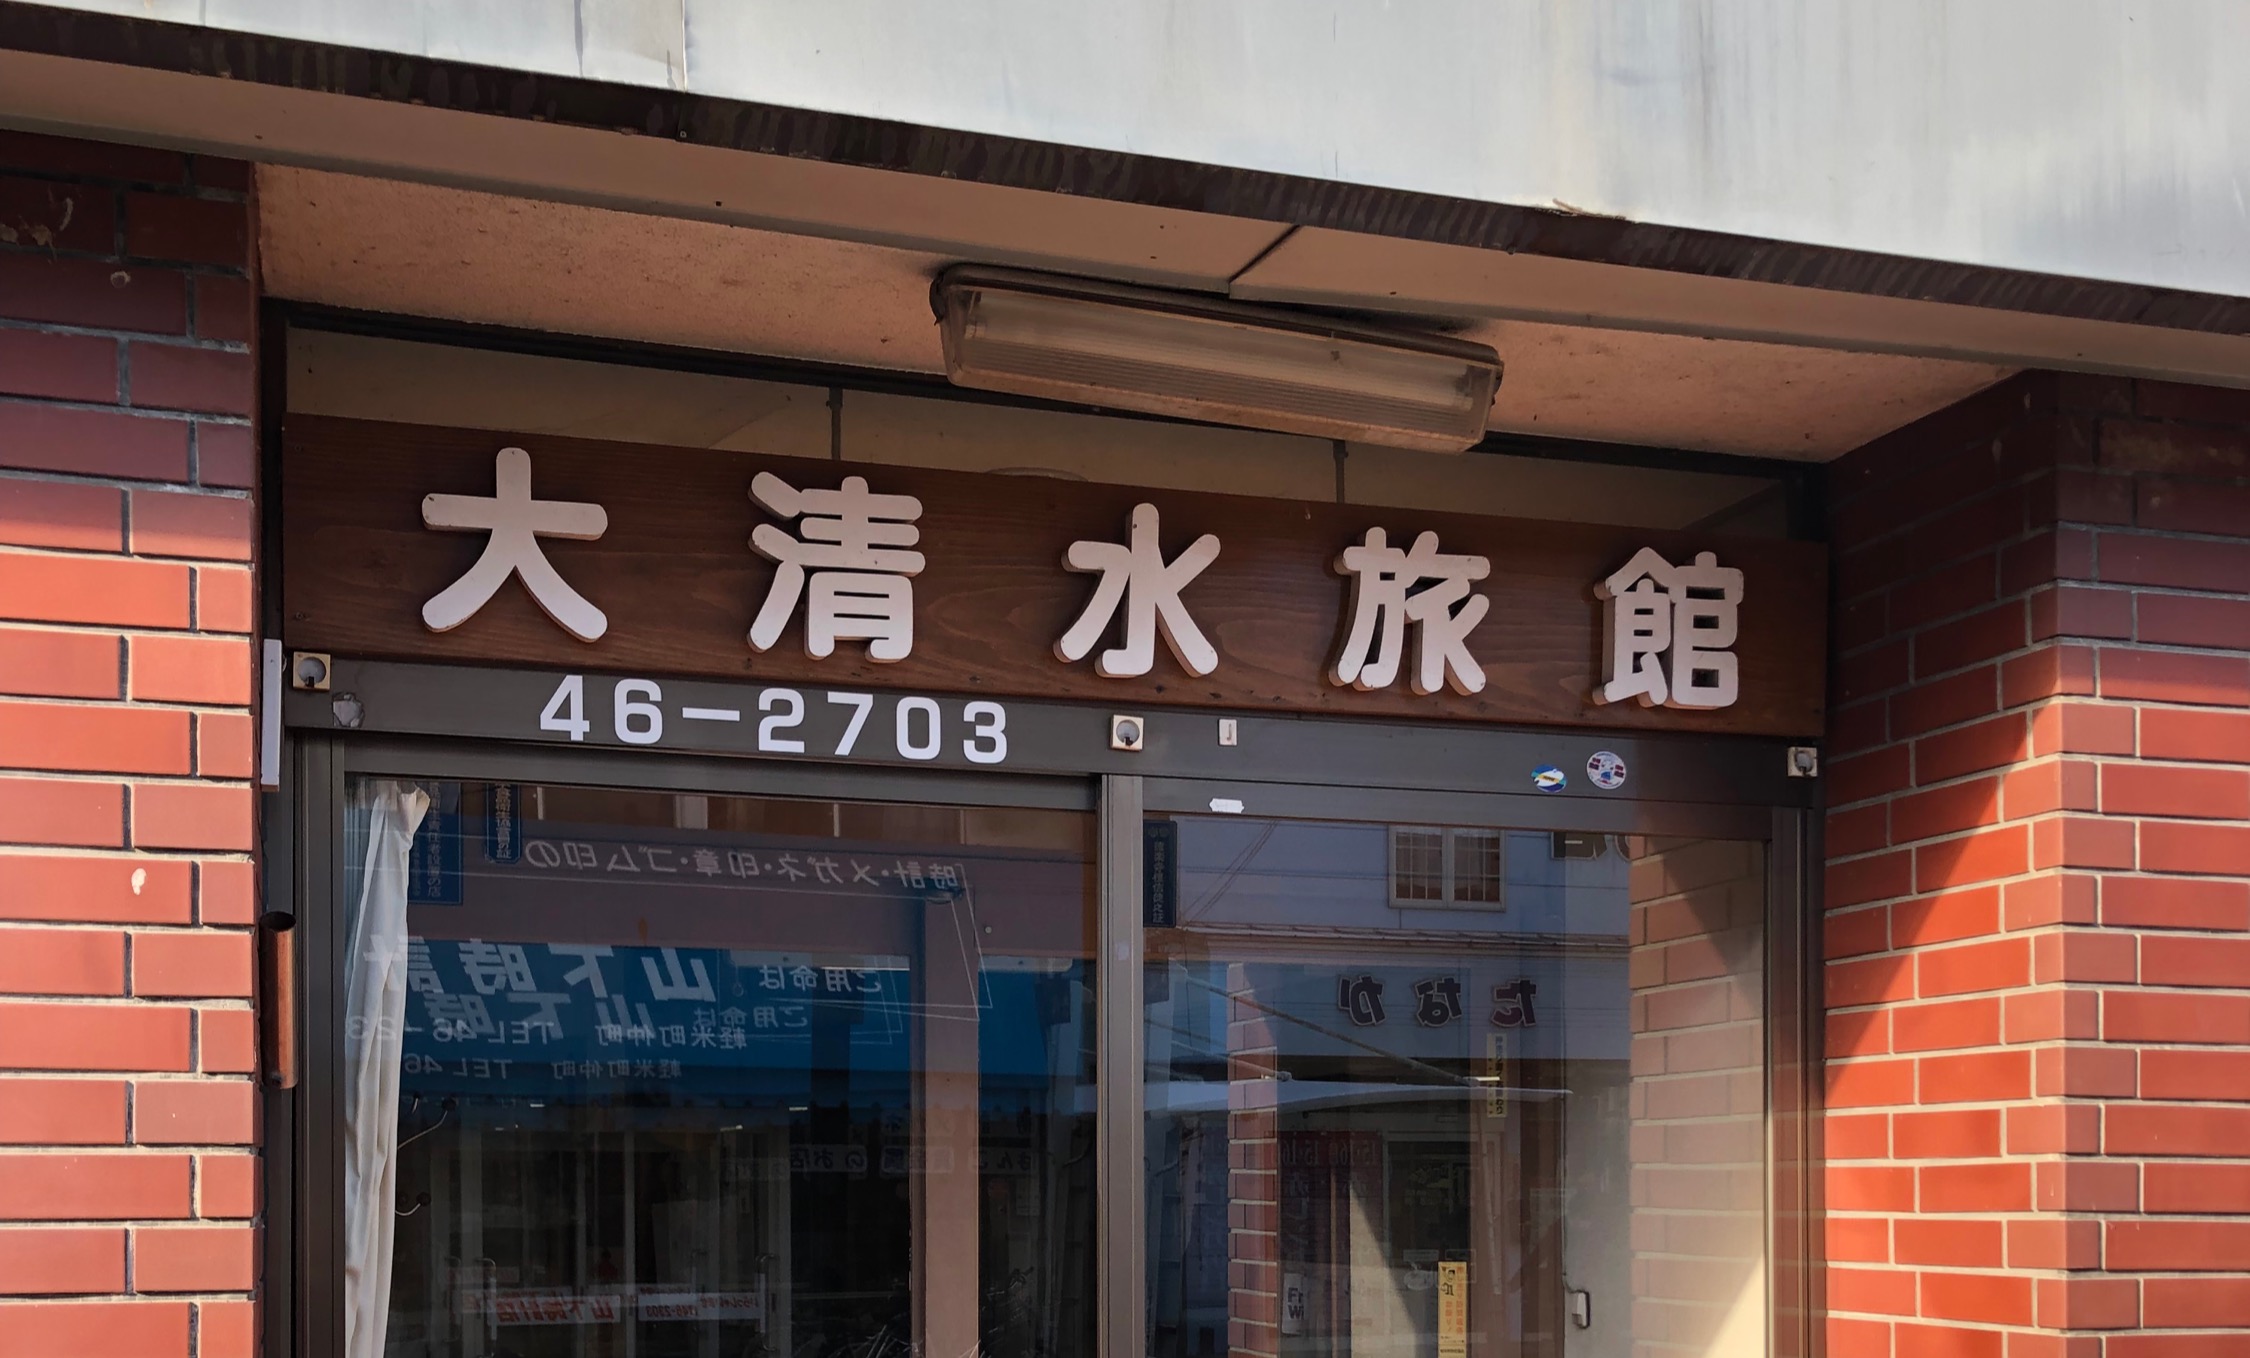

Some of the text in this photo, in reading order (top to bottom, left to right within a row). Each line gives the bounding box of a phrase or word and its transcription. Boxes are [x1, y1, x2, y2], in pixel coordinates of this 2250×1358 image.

[422, 447, 1744, 711] 大清水旅館
[539, 675, 1008, 764] 46-2703
